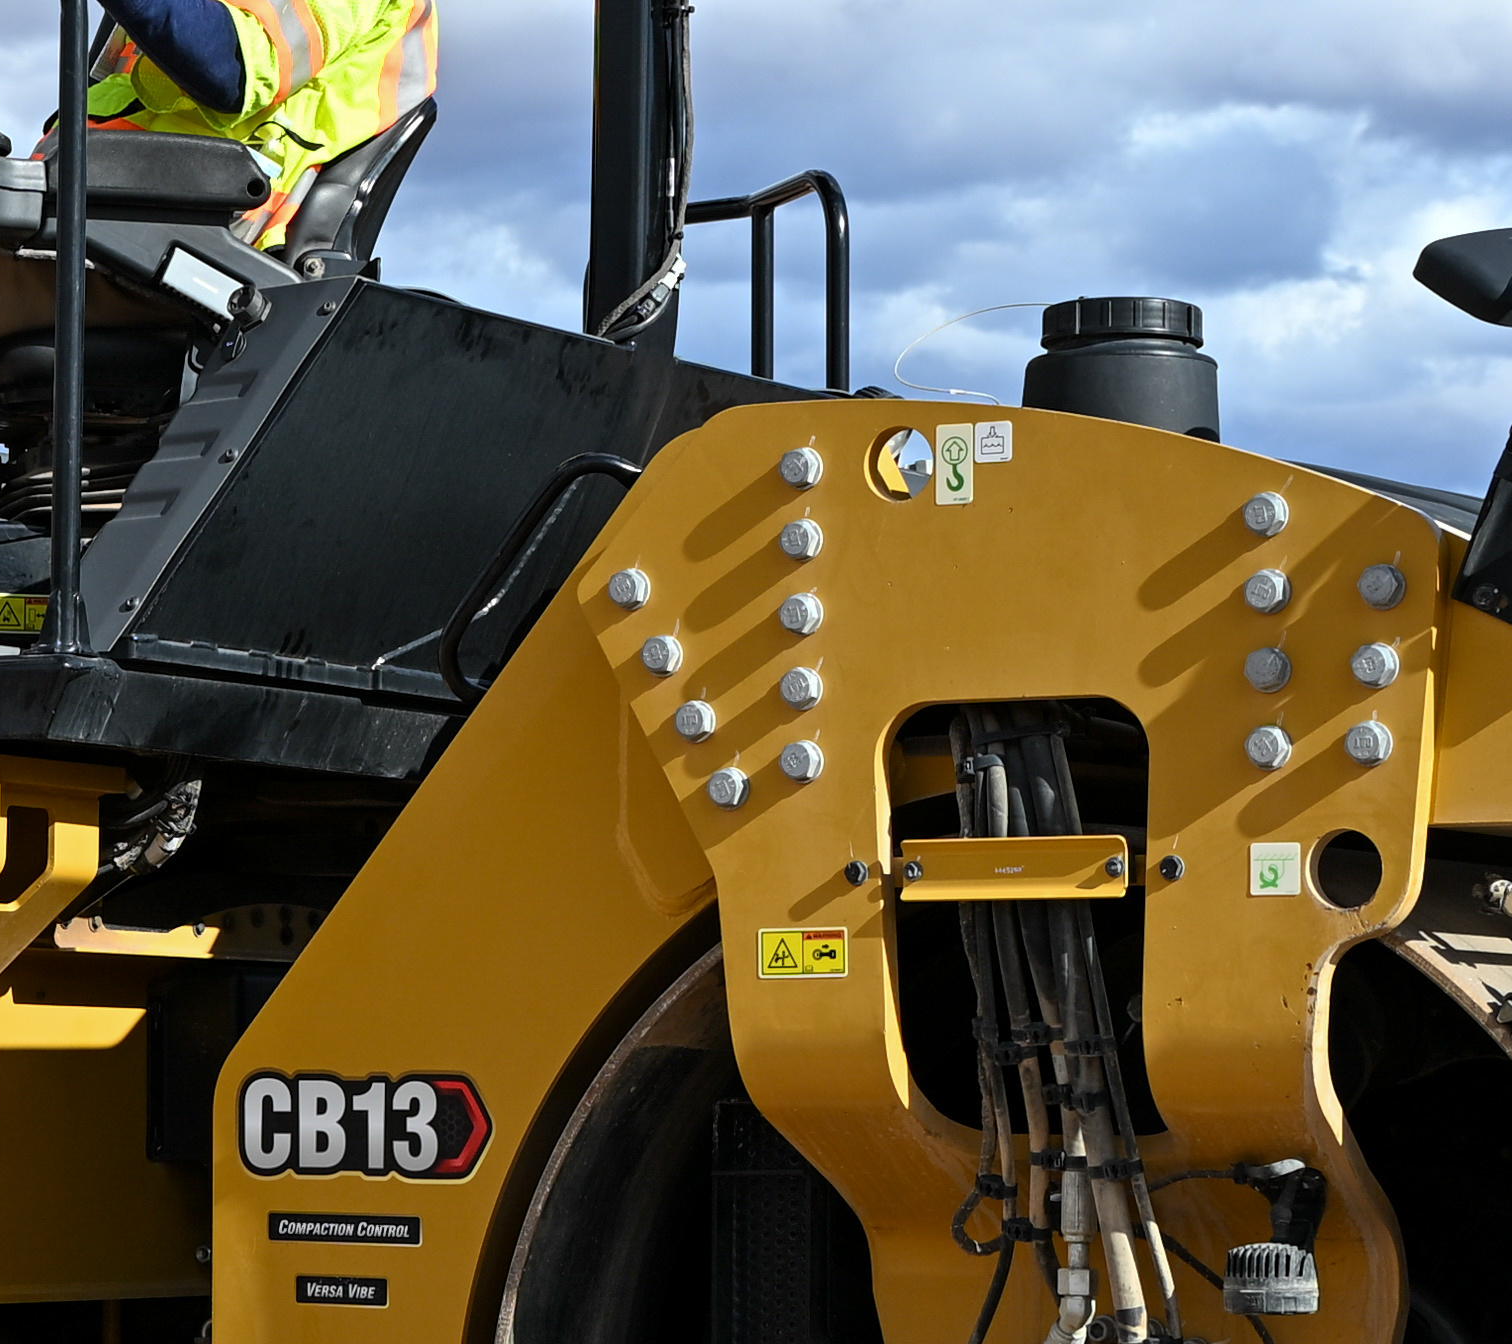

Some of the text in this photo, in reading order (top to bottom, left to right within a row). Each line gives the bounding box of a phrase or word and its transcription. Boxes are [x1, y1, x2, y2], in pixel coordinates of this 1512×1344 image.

[244, 1077, 439, 1172] CB13
[278, 1219, 410, 1238] COMPACTION CONTROL
[306, 1282, 376, 1299] VERSA VIBE
